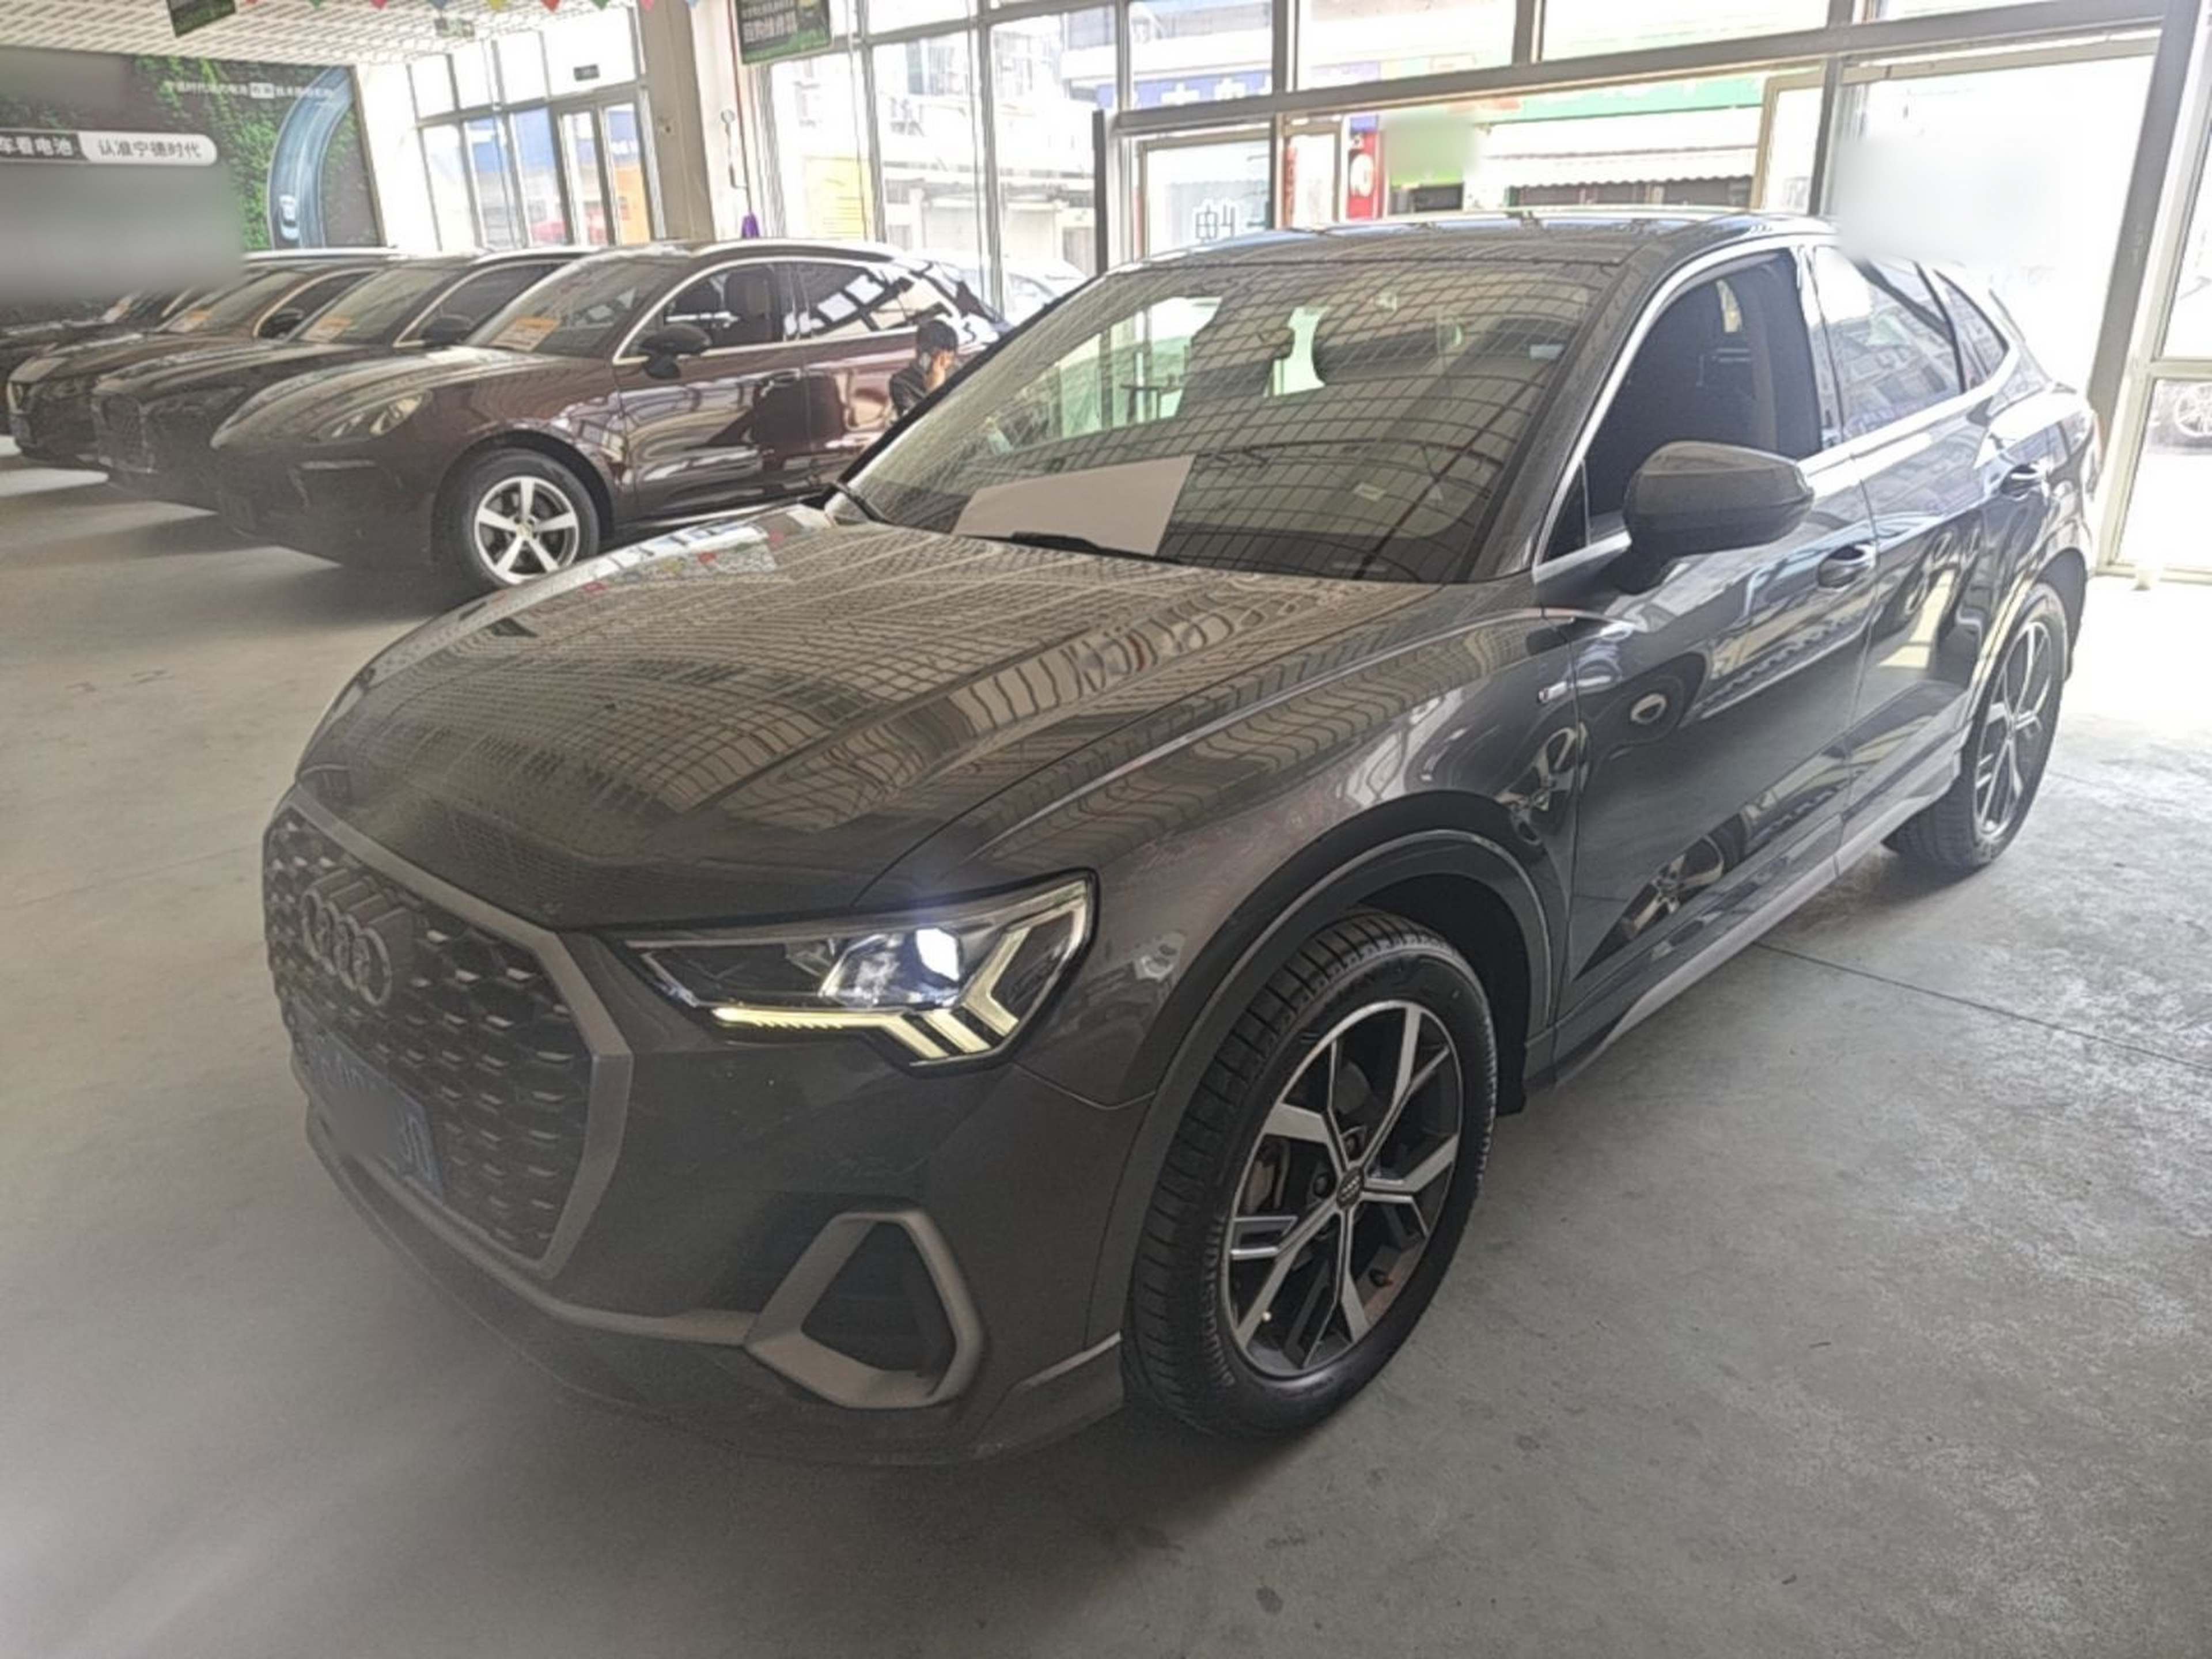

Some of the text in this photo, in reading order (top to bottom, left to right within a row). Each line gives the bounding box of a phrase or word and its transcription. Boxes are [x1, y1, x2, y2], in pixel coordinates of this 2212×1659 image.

[99, 139, 202, 158] 认准宁德时代
